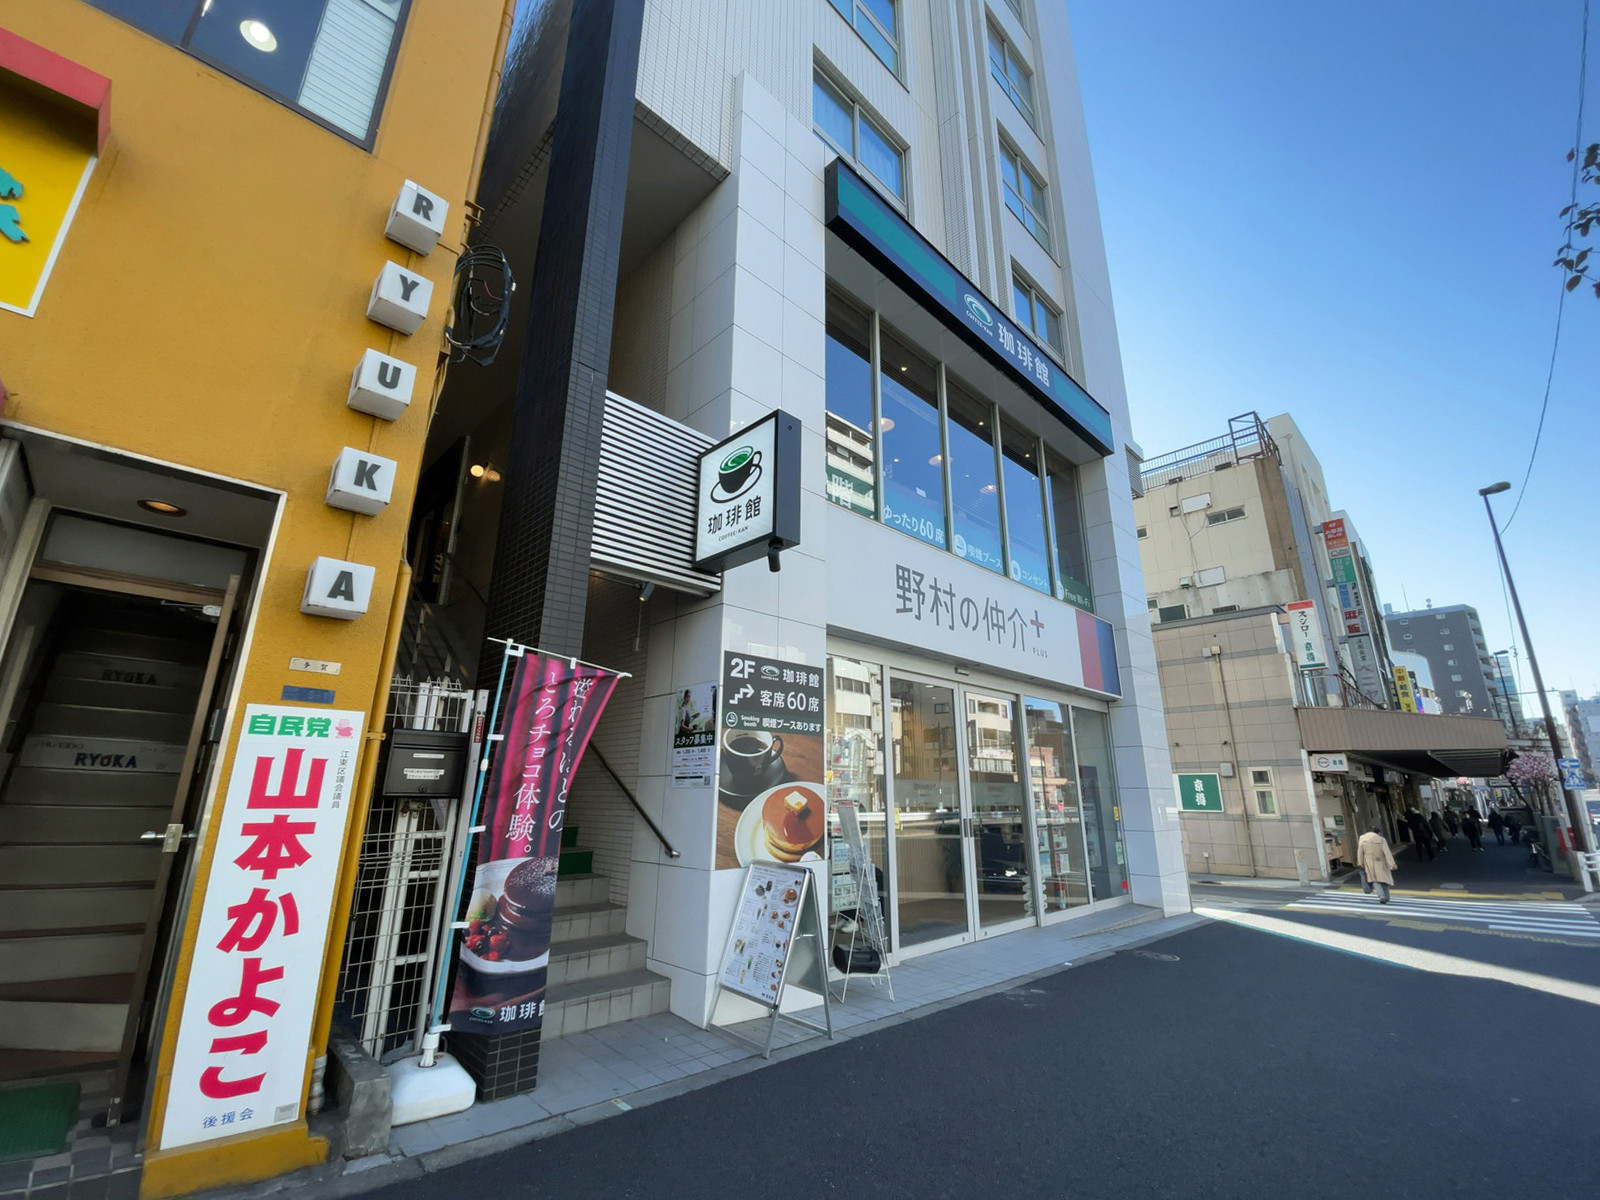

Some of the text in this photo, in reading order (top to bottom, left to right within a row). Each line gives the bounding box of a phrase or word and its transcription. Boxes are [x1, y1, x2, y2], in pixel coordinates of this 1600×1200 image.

[997, 322, 1050, 387] 珈琲館
[708, 494, 762, 535] 珈琲館
[883, 504, 945, 544] ゆったり60席
[1298, 610, 1309, 638] スシロー
[1032, 647, 1048, 659] PLUS
[730, 657, 756, 679] 2F
[782, 668, 819, 688] 珈琲館
[760, 689, 819, 712] 客席60席
[247, 713, 332, 739] 自民党
[762, 717, 822, 733] 喫煙ブースあります
[674, 732, 714, 746] スタッフ募集中
[74, 752, 137, 768] RYOKA
[331, 749, 350, 809] 江東区議会議員
[199, 748, 329, 1100] 山本かよこ
[202, 1107, 254, 1130] 後援会
